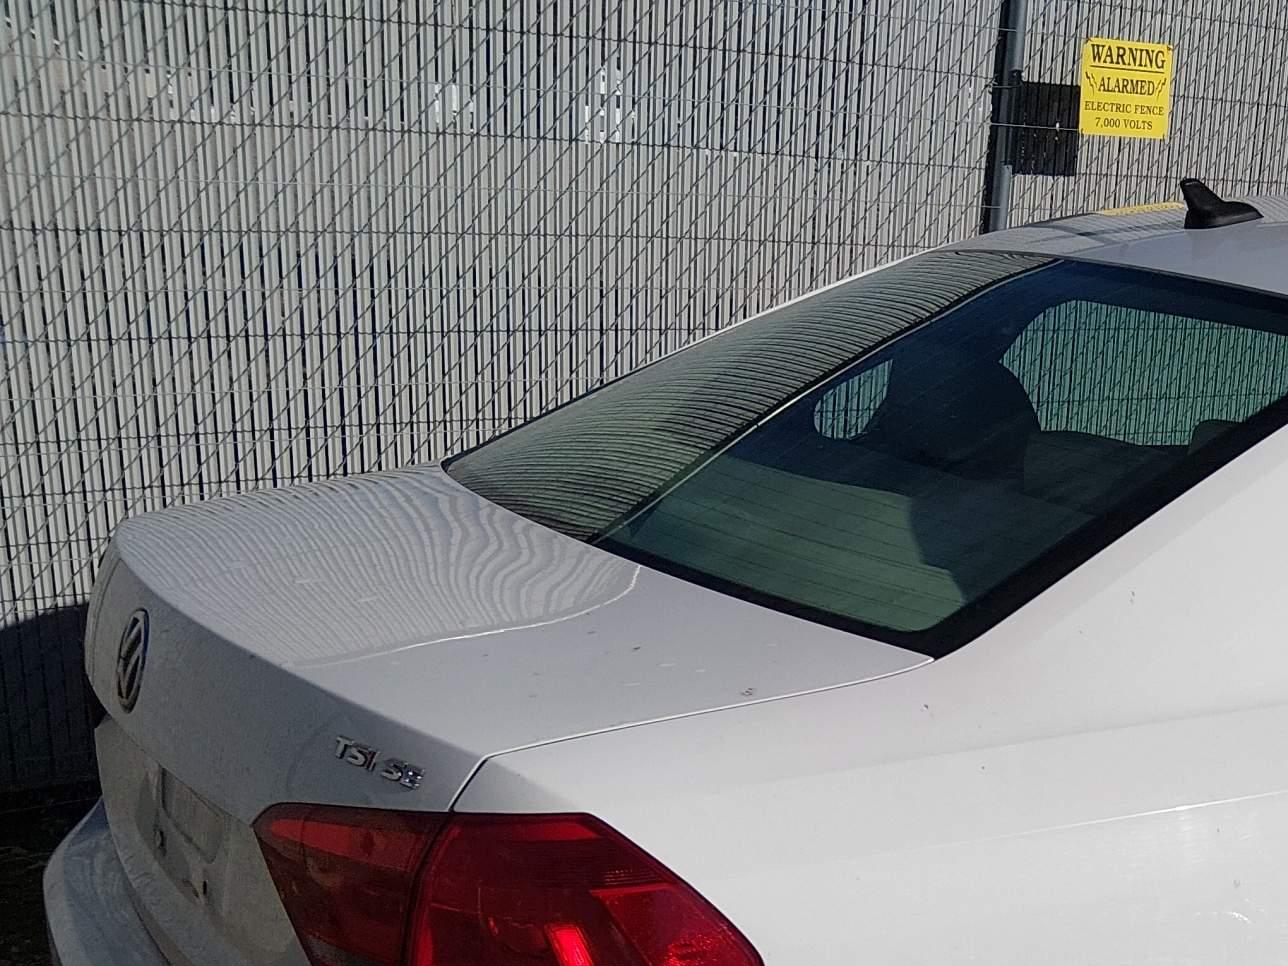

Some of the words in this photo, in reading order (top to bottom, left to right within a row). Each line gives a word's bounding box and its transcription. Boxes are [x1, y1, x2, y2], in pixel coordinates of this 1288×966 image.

[1090, 43, 1166, 69] WARNING
[1098, 76, 1155, 96] ALARMED
[1084, 101, 1132, 114] ELECTRIC
[1134, 104, 1165, 116] FENCE
[1095, 117, 1121, 129] 7,000
[1123, 119, 1153, 130] VOLTS
[335, 736, 381, 772] TSI
